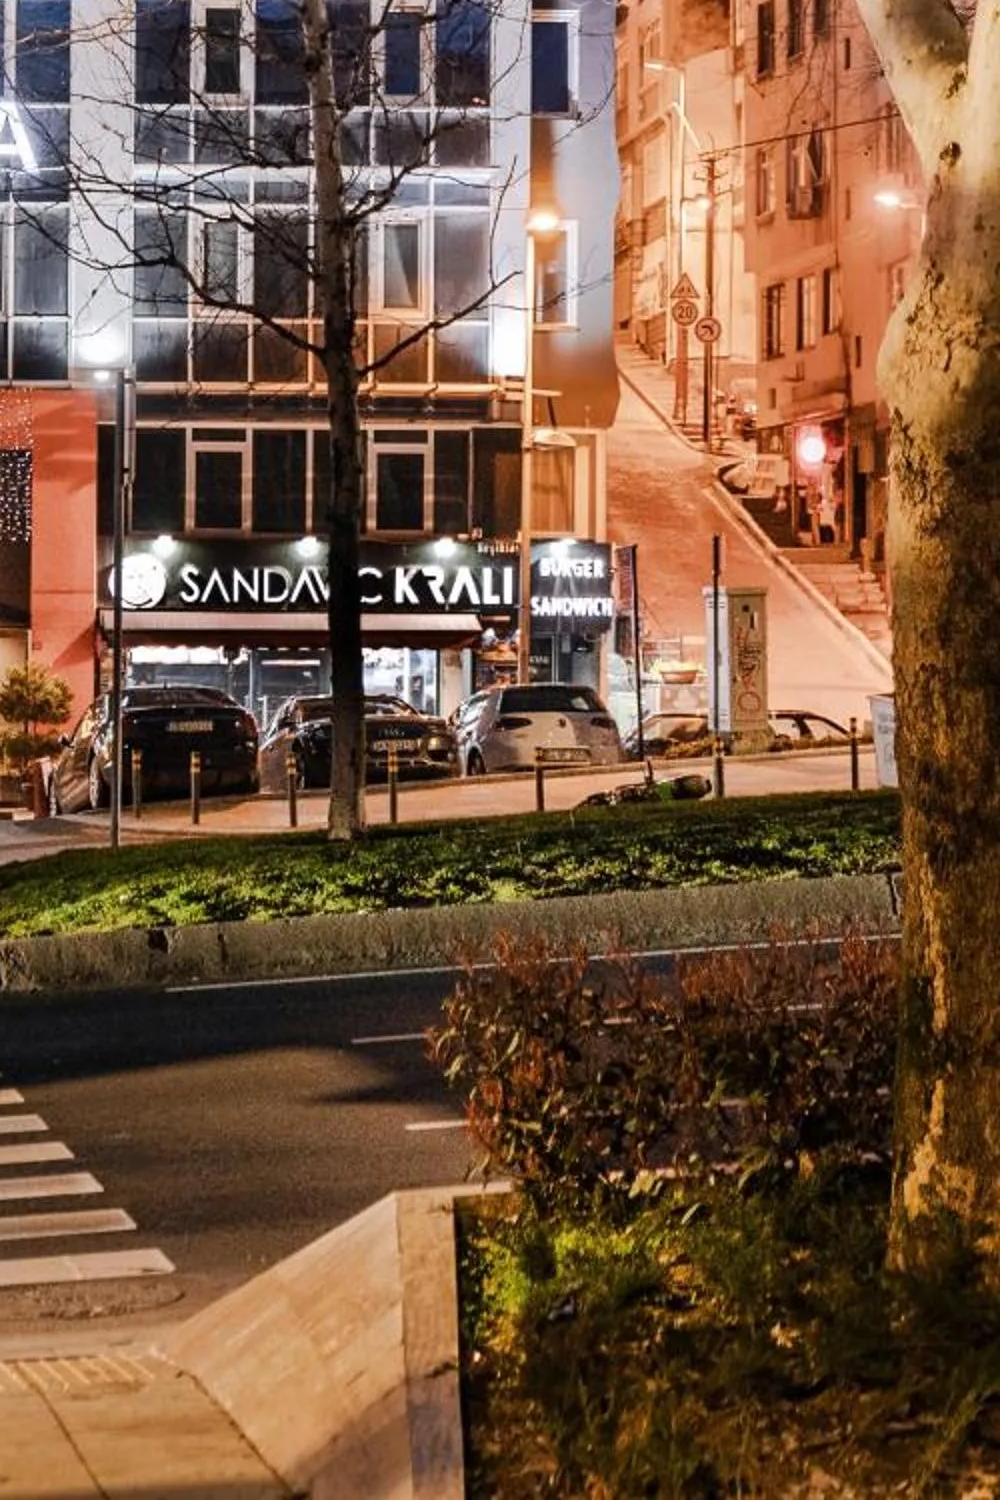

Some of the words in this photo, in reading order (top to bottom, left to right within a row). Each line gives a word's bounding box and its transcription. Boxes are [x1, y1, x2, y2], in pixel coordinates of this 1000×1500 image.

[678, 306, 693, 319] 20
[539, 556, 604, 578] BURGER
[395, 566, 513, 605] KRALI
[531, 596, 614, 616] SANDWICH
